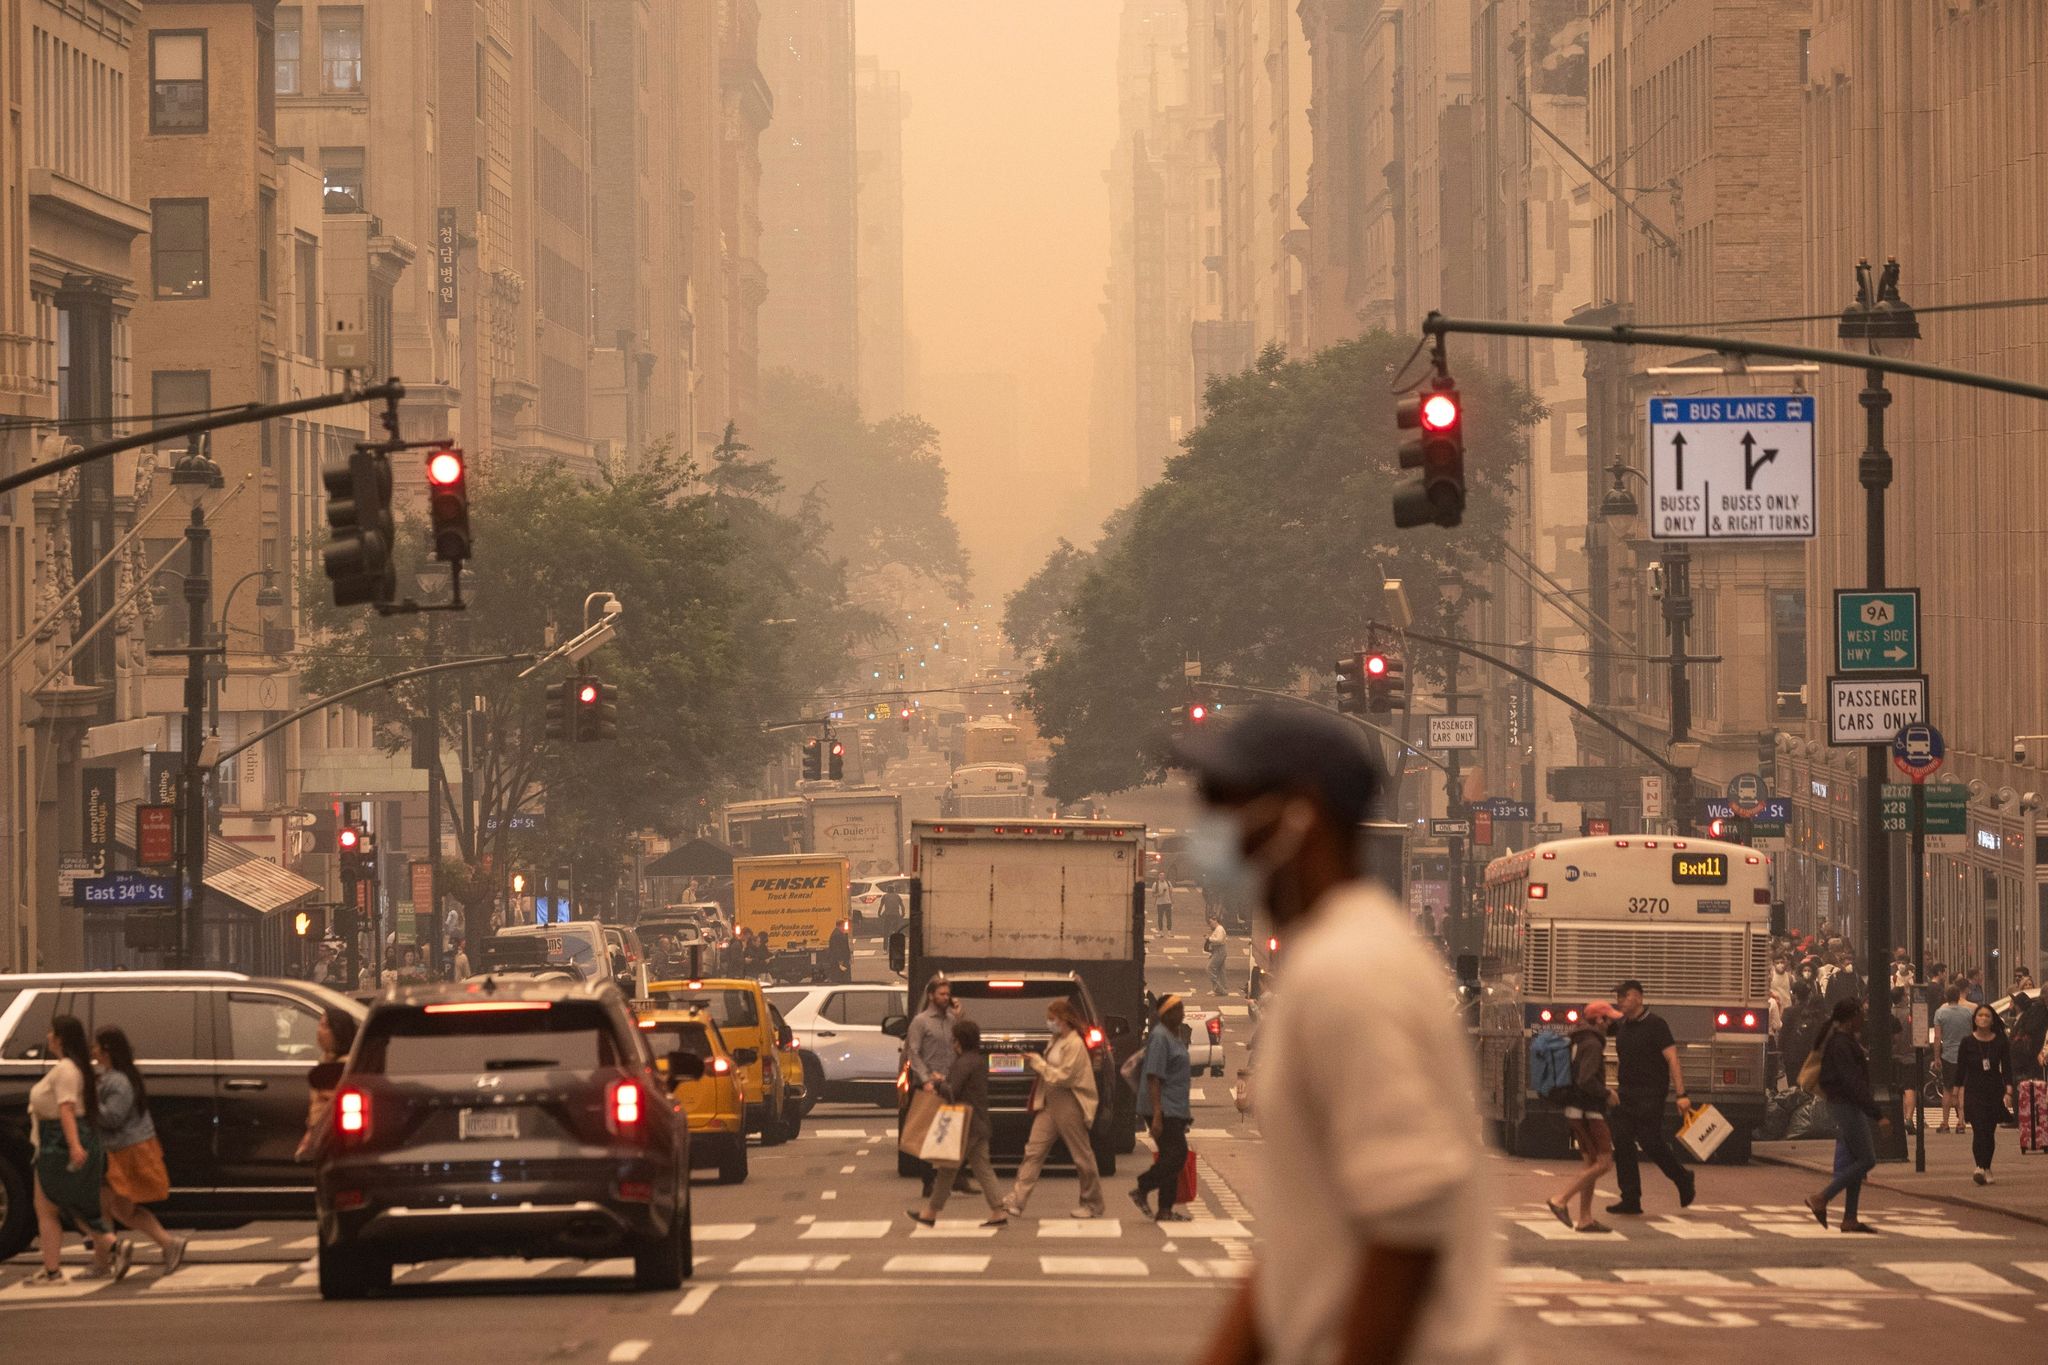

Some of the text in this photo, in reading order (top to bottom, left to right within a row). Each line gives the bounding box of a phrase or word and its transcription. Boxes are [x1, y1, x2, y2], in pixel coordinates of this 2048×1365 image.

[440, 227, 454, 303] 청담병원
[1689, 402, 1776, 420] BUS LANES
[1660, 496, 1700, 511] BUSES
[1721, 494, 1799, 511] BUSES ONLY
[1663, 516, 1696, 531] ONLY
[1712, 515, 1810, 531] & RIGHT TURNS
[1866, 606, 1888, 621] 9A
[1846, 629, 1909, 642] WEST SIDE
[1847, 648, 1872, 661] HWY
[1838, 689, 1917, 707] PASSENGER
[1432, 720, 1474, 730] PASSENGER
[1838, 713, 1874, 731] CARS
[1432, 732, 1474, 742] CARS ONLY
[1518, 806, 1529, 817] St
[1707, 804, 1735, 818] Wes
[1770, 804, 1784, 818] St
[1883, 802, 1906, 814] x28
[1883, 818, 1906, 830] x38
[936, 848, 943, 857] 2
[1117, 850, 1124, 859] 2
[1679, 857, 1721, 876] BxM11
[85, 886, 115, 900] East
[119, 883, 146, 900] 34th
[149, 884, 164, 899] St
[750, 876, 829, 892] PENSKE
[767, 891, 813, 900] Truck Rental
[1628, 898, 1670, 914] 3270
